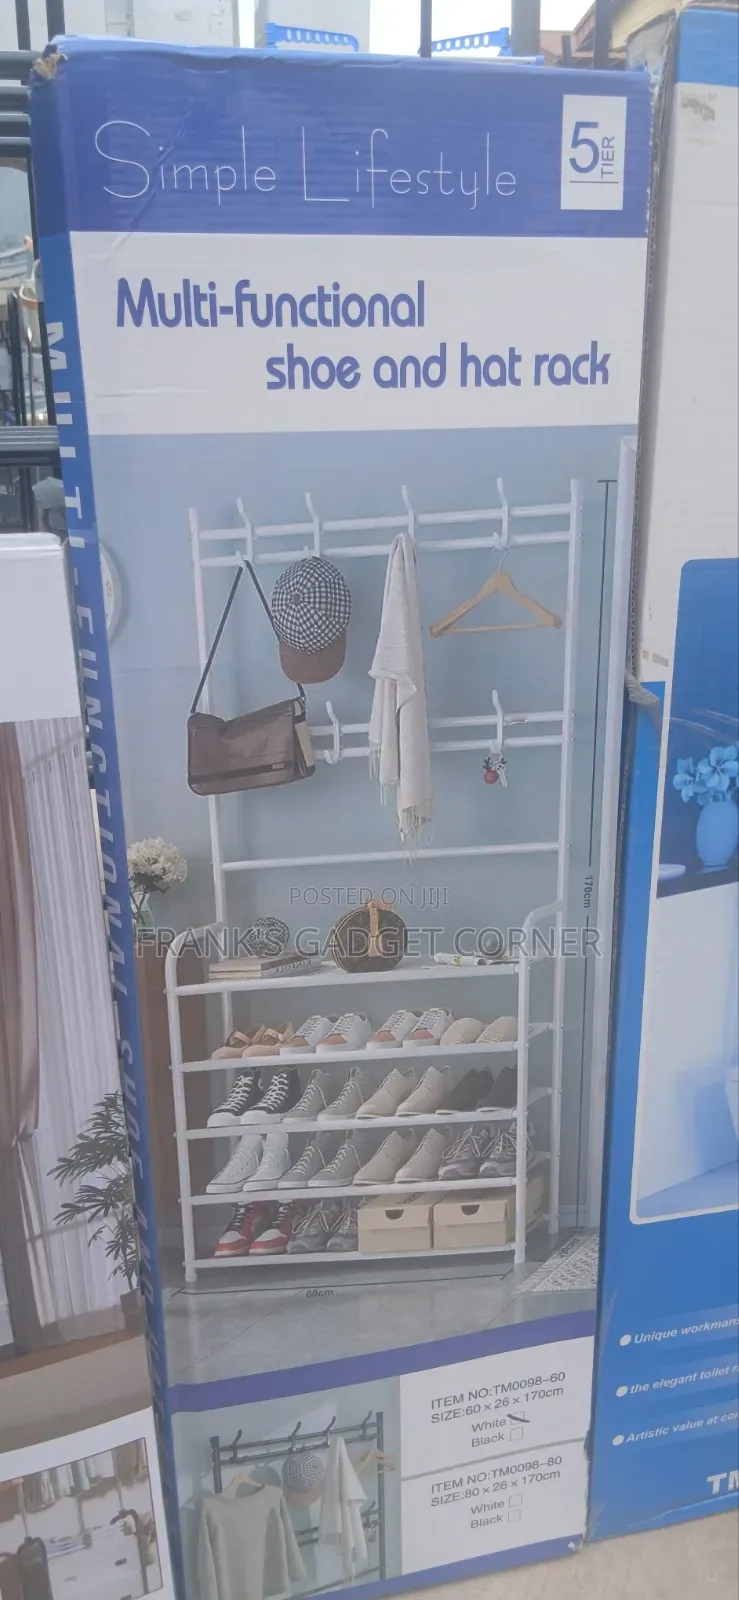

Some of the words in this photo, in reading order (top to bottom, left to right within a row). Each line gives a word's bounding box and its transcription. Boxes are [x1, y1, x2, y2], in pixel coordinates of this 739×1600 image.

[569, 120, 600, 175] 5
[601, 135, 616, 180] TIER
[94, 120, 277, 206] Simple
[301, 126, 518, 209] Lifestyle
[116, 277, 425, 329] Multi-functional
[265, 344, 362, 391] shoe
[373, 343, 447, 389] and
[459, 342, 521, 388] hat
[533, 340, 612, 387] rack
[583, 875, 594, 909] 170cm
[306, 1289, 334, 1299] 60cm
[634, 1328, 678, 1344] Unique
[630, 1382, 650, 1395] the
[652, 1372, 697, 1390] elegant
[699, 1365, 730, 1380] toilet
[430, 1403, 481, 1424] SIZE:60
[494, 1397, 510, 1410] 26
[525, 1387, 564, 1402] 170cm
[431, 1393, 465, 1410] ITEM
[471, 1432, 505, 1448] Black
[472, 1418, 507, 1433] White
[626, 1425, 670, 1444] Artistic
[672, 1418, 704, 1433] value
[706, 1415, 719, 1425] at
[430, 1487, 480, 1507] SIZE:80
[492, 1480, 508, 1493] 26
[522, 1470, 561, 1485] 170cm
[431, 1477, 463, 1494] ITEM
[470, 1501, 505, 1515] White
[470, 1514, 504, 1529] Black
